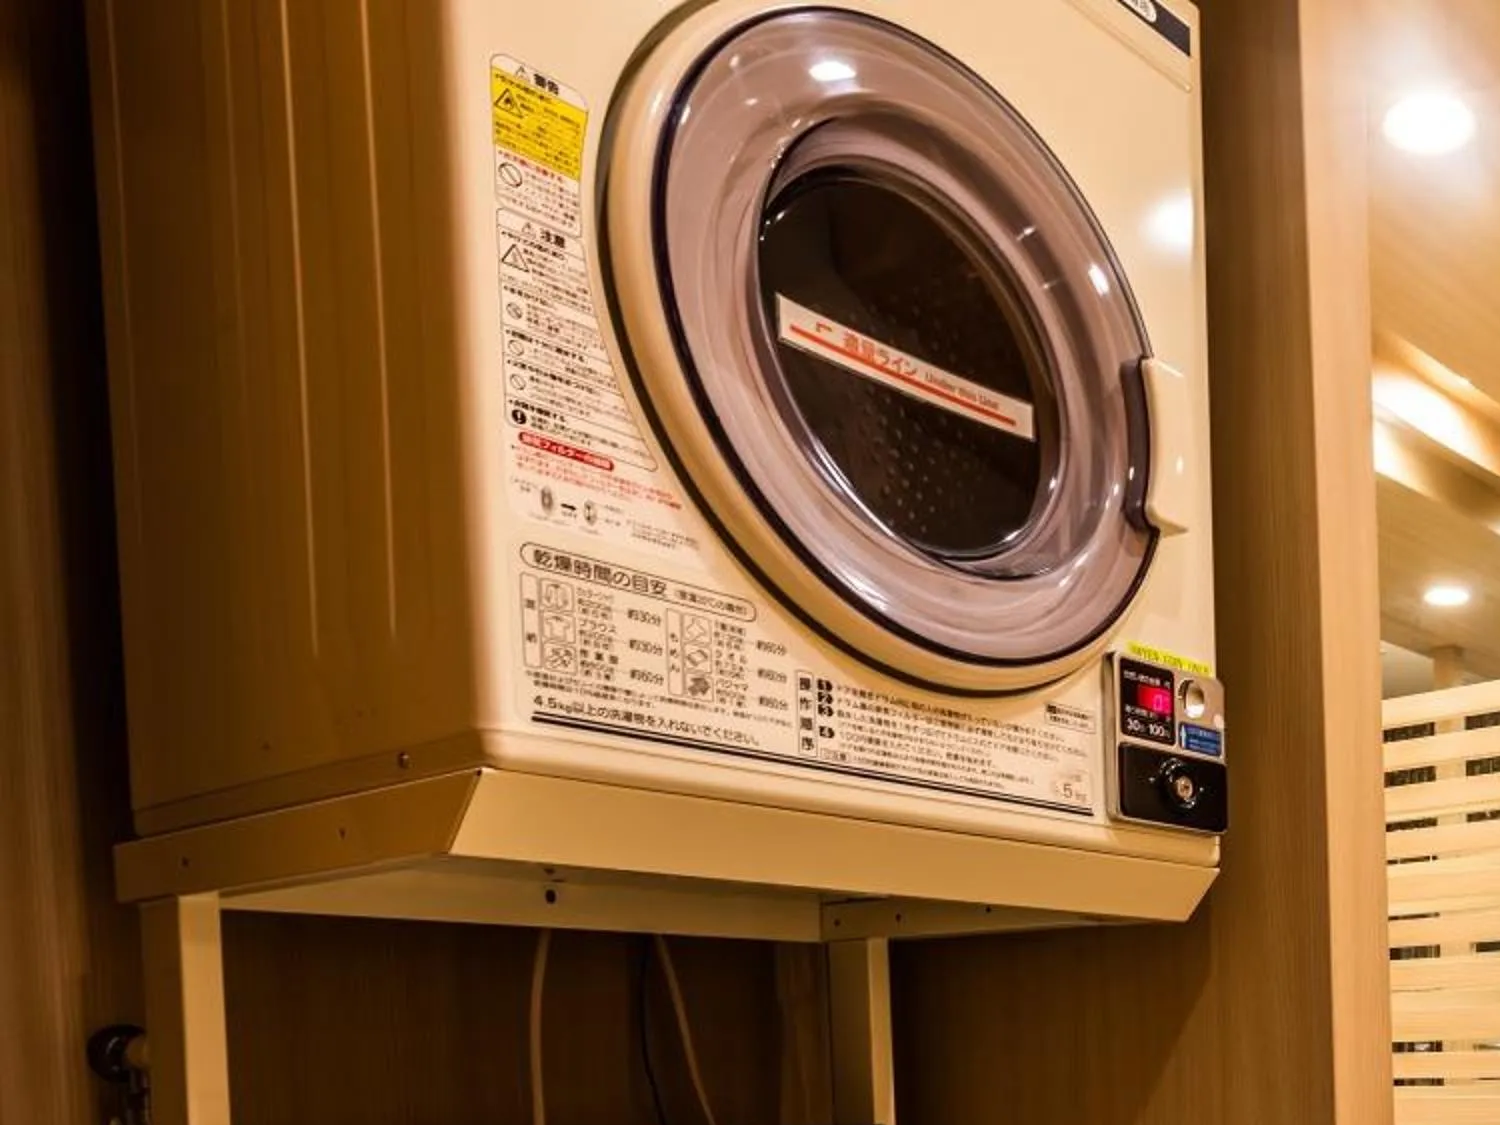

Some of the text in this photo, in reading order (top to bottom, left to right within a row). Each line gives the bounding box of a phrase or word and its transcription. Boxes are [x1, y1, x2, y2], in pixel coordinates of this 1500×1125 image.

[533, 547, 667, 596] 乾燥時間の目安
